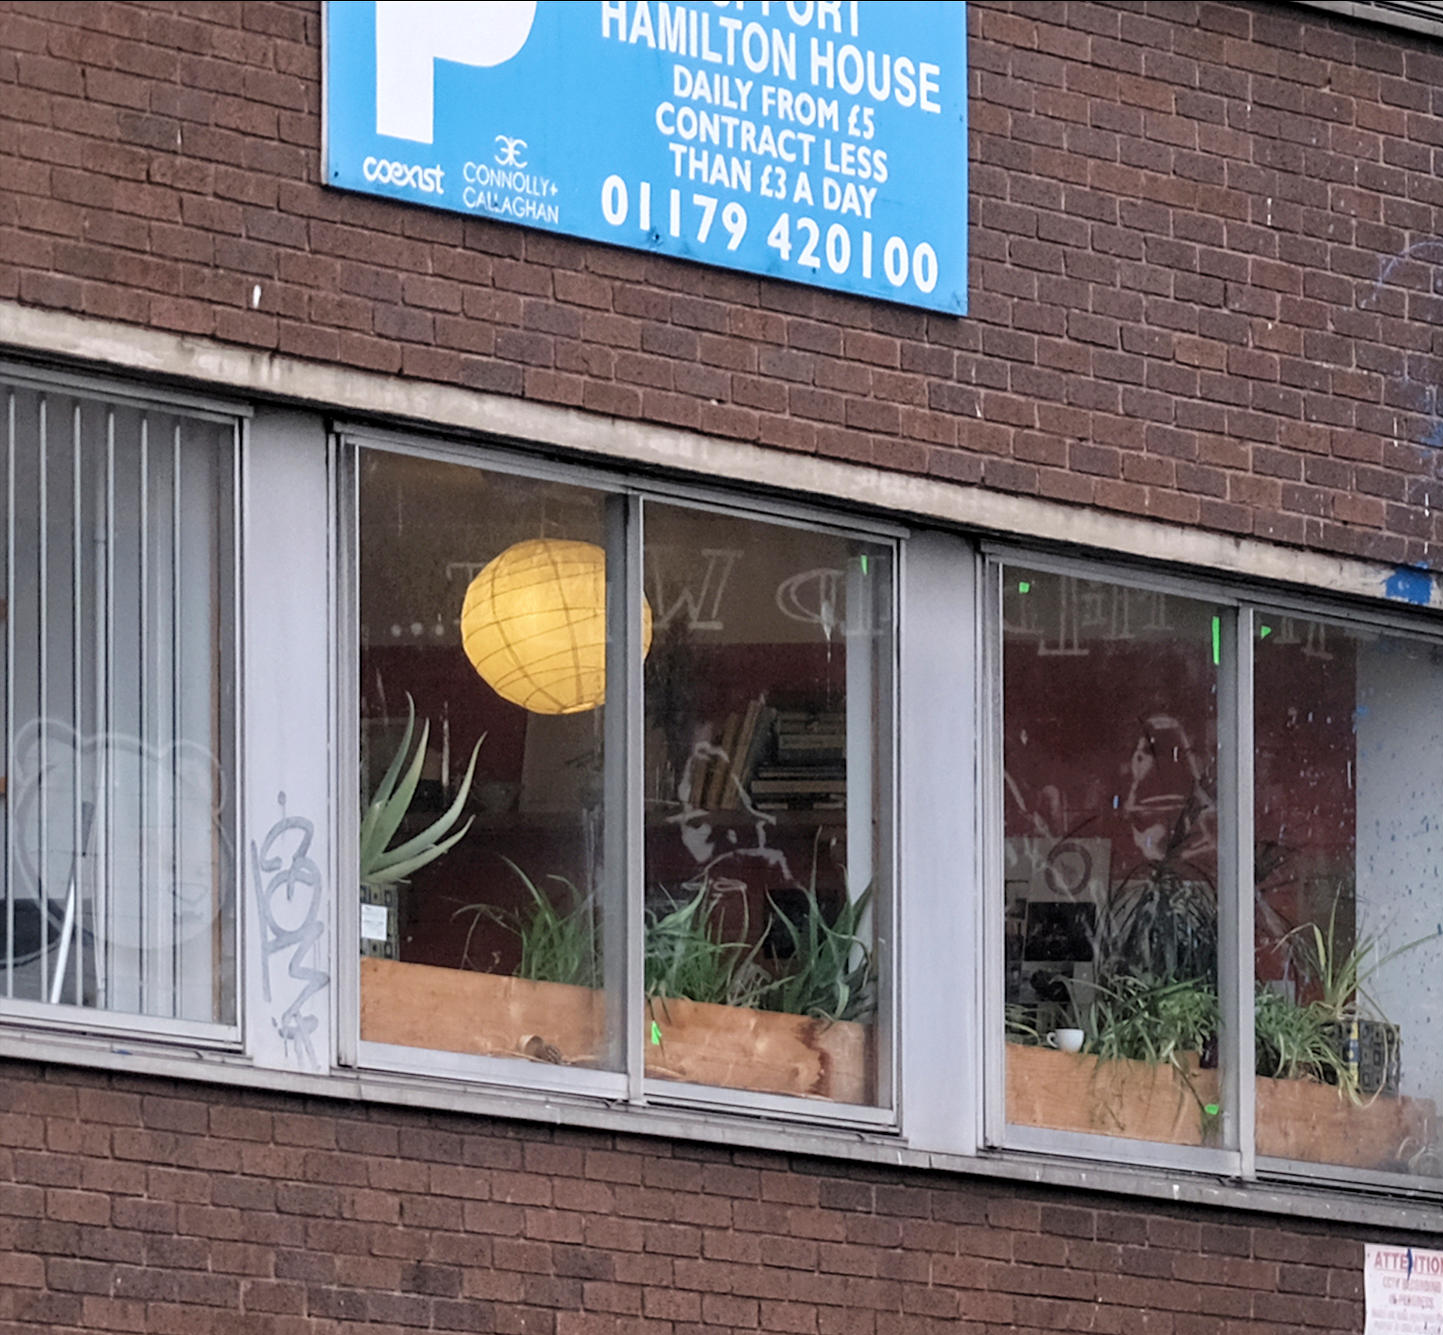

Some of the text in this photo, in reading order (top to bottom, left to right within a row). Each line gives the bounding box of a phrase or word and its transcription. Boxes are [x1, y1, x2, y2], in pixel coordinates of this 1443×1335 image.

[602, 0, 796, 81] HAMILTON
[811, 37, 941, 113] HOUSE
[673, 64, 875, 140] DAILY FROM £5
[363, 156, 445, 195] coexist
[655, 101, 888, 183] CONTRACT LESS
[669, 142, 877, 219] THAN £3 A DAY
[463, 186, 559, 225] CALLAGHAN
[601, 174, 938, 293] 01179 420100
